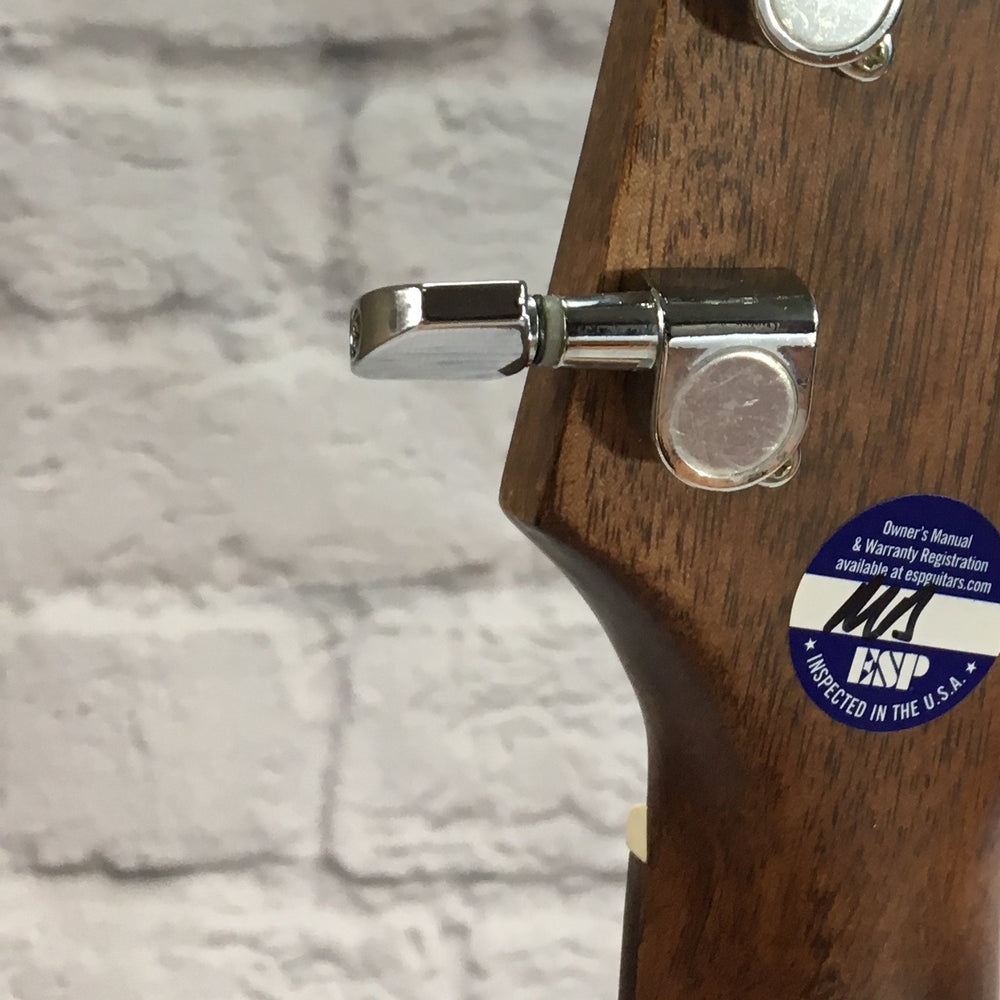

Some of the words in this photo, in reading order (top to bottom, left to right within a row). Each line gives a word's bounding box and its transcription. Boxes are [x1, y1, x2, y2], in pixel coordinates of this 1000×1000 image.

[882, 519, 929, 542] Owner's
[930, 528, 974, 549] Manual
[852, 536, 862, 552] &
[865, 538, 920, 564] Warranty
[920, 548, 989, 573] Registration
[835, 558, 889, 576] available
[890, 564, 904, 579] at
[904, 569, 992, 594] espguitars.com
[846, 646, 931, 691] ESP
[806, 653, 867, 718] INSPECTED
[870, 704, 888, 722] IN
[892, 699, 920, 721] THE
[923, 676, 966, 711] U.S.A.
